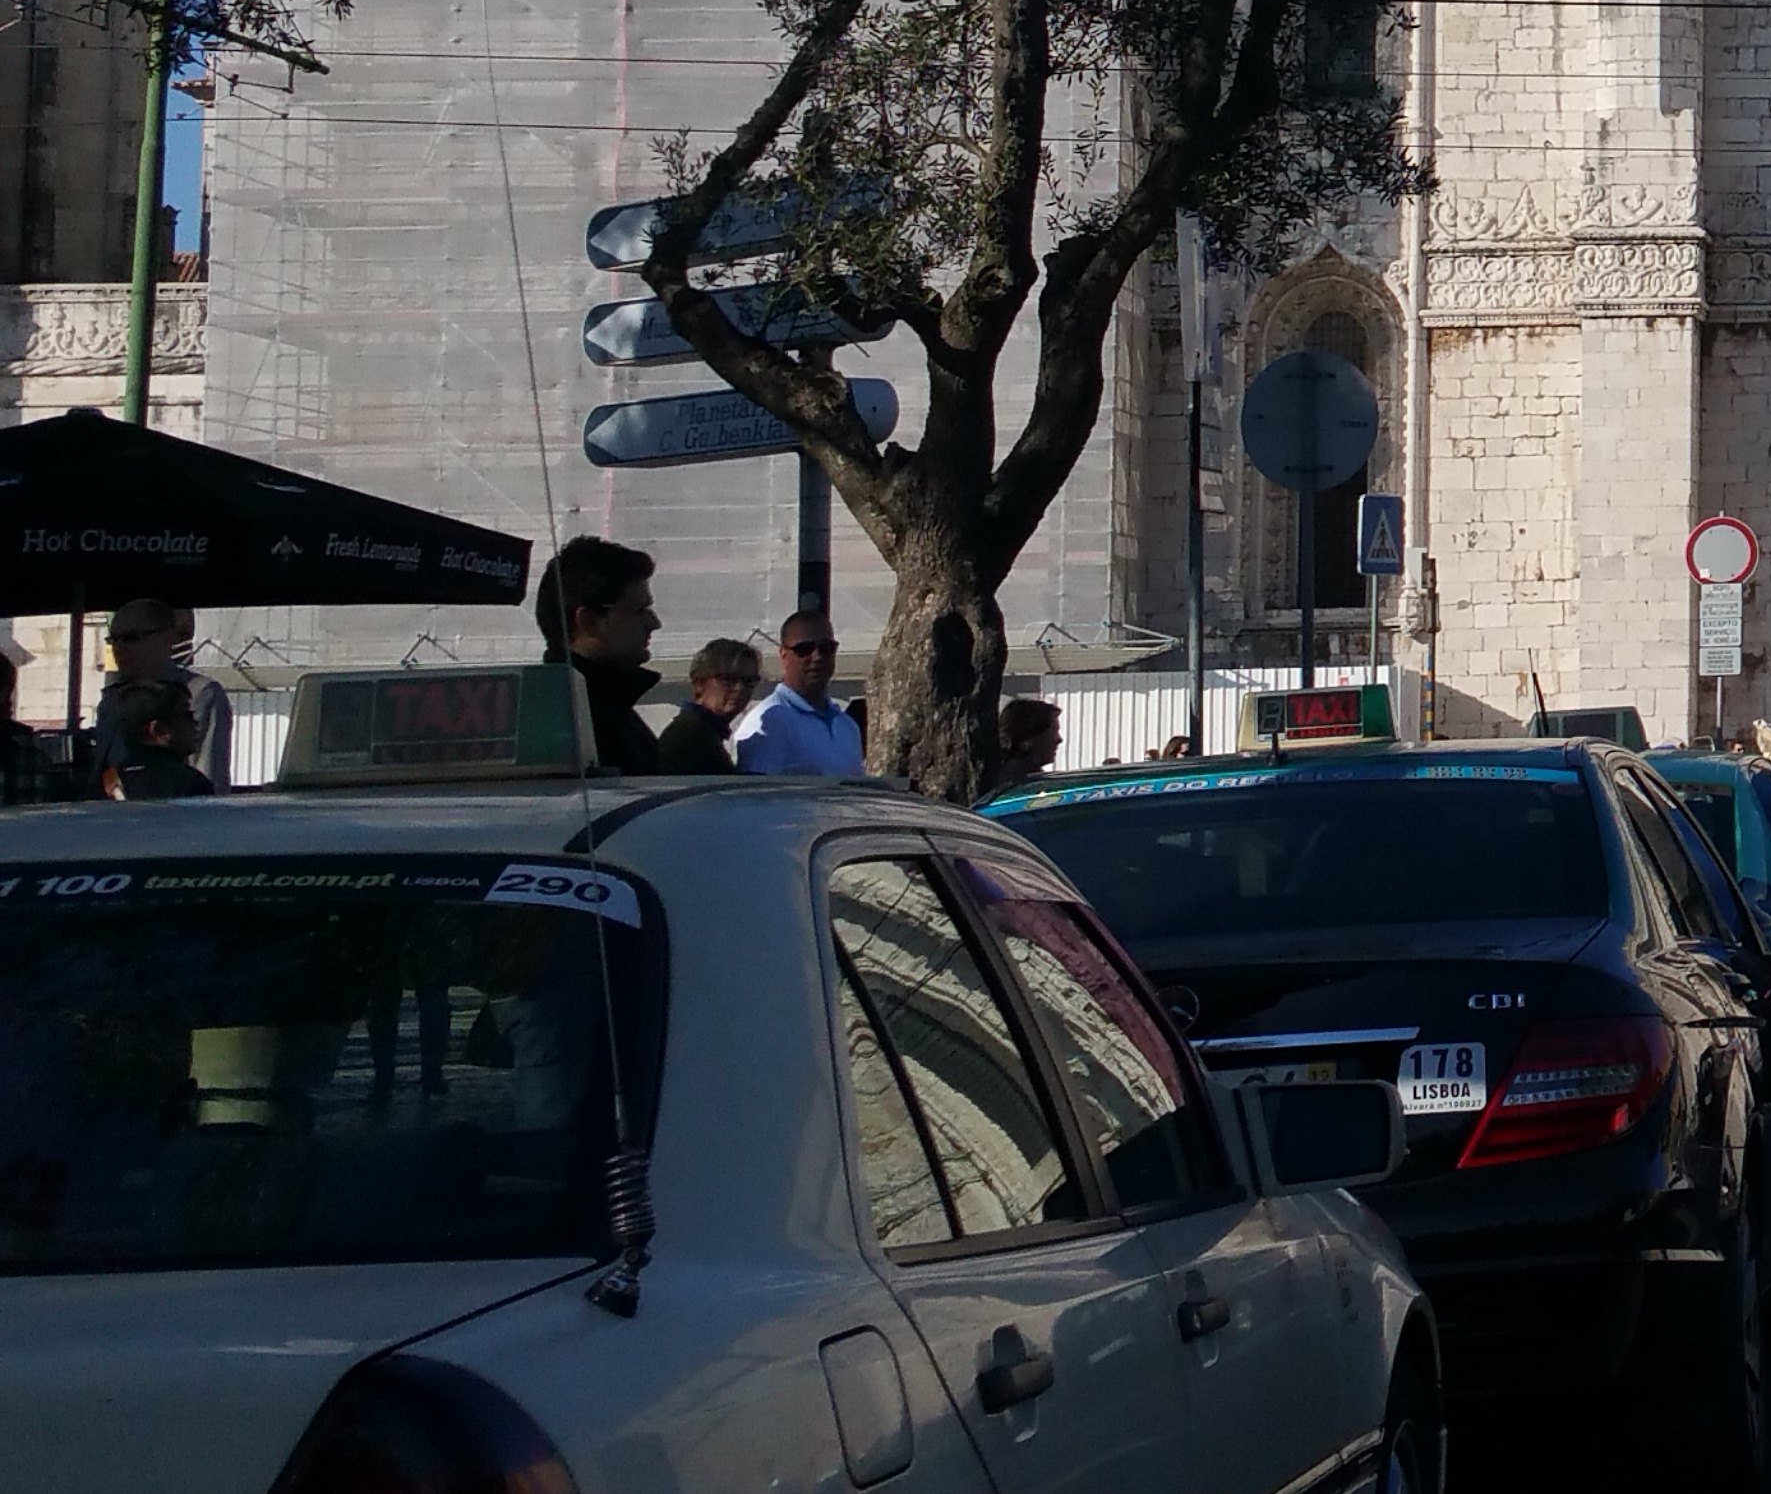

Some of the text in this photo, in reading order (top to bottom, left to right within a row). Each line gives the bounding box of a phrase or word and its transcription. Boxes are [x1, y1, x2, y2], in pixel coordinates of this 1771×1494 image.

[22, 528, 209, 554] Hot Chocolate
[325, 532, 360, 557] Fresh
[440, 546, 521, 580] Hot Chocolate
[386, 679, 510, 737] TAXI
[1289, 692, 1359, 725] TAXI
[1073, 783, 1156, 804] TAXIS
[1162, 780, 1209, 793] DO
[36, 874, 132, 897] 100
[144, 872, 396, 890] taxinet.com.pt
[401, 876, 480, 887] LISBOA
[493, 873, 611, 904] 290
[1468, 992, 1526, 1009] CDI
[1409, 1047, 1474, 1080] 178
[1412, 1082, 1471, 1100] LISBOA
